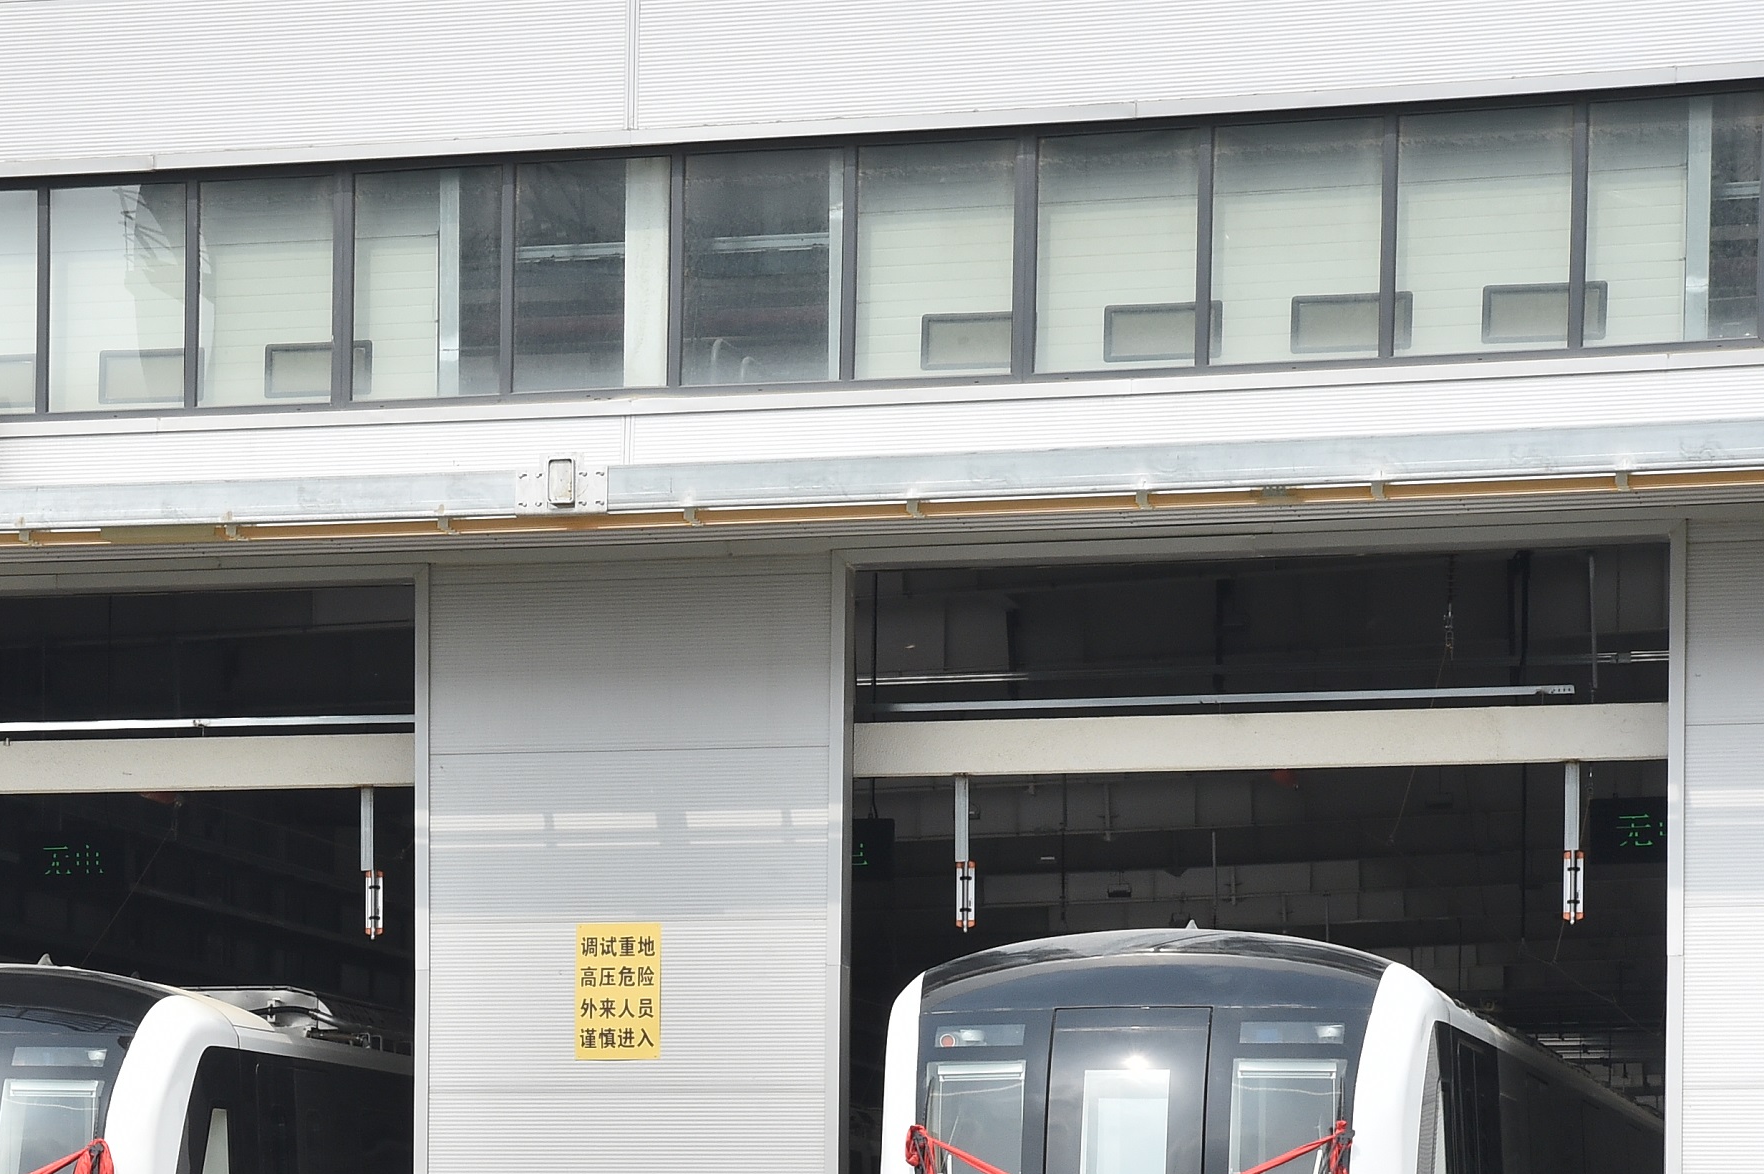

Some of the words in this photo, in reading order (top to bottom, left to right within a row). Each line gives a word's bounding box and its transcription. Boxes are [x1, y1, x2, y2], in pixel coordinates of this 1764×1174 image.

[580, 936, 656, 957] 调试重地
[580, 966, 655, 988] 高压危险
[580, 997, 654, 1019] 外来人员
[579, 1028, 654, 1049] 谨慎进入
